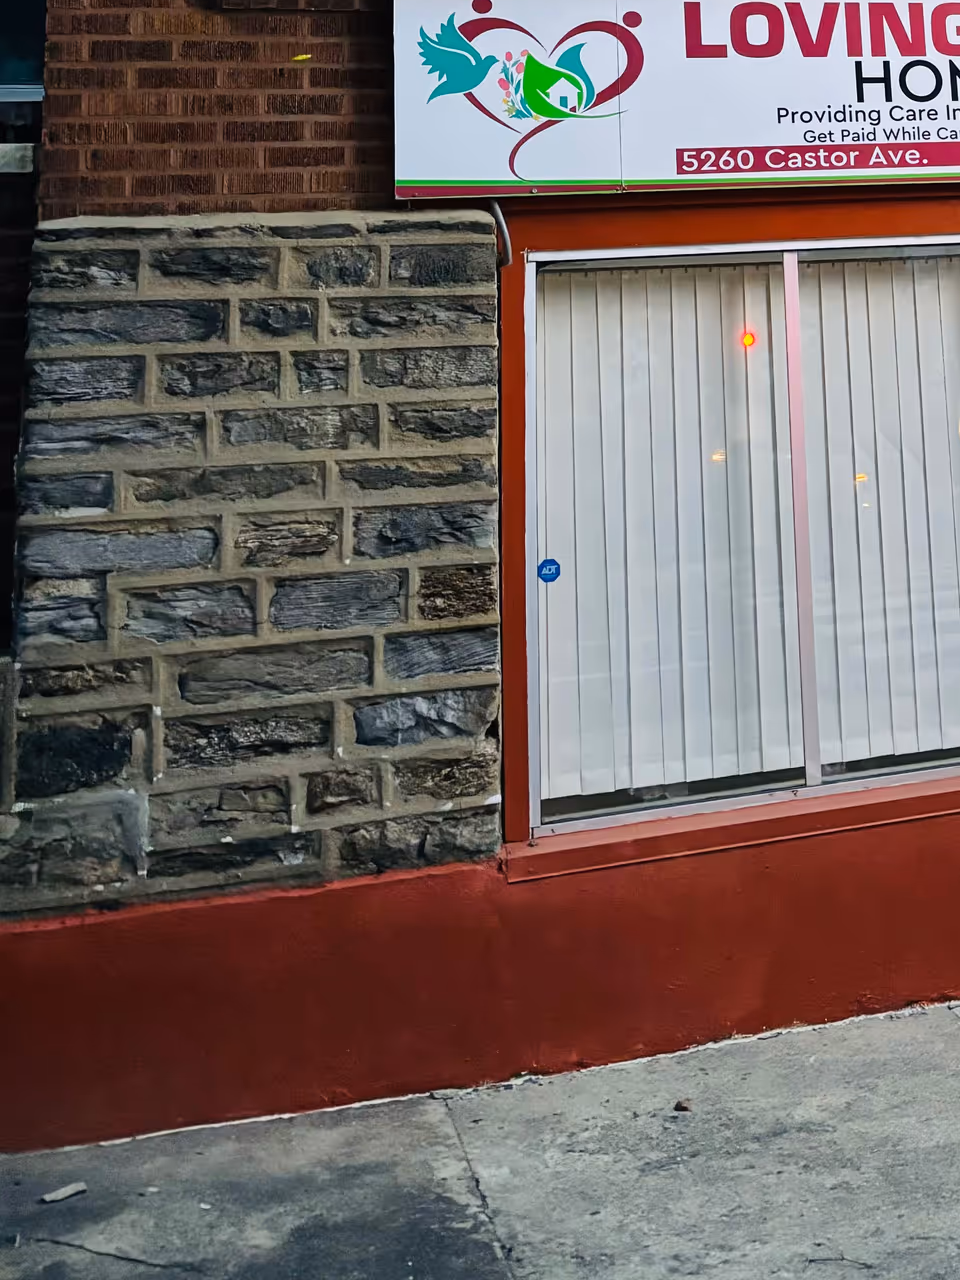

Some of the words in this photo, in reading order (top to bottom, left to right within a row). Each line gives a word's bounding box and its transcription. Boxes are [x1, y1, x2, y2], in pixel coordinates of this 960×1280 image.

[777, 105, 881, 125] Providing
[889, 105, 938, 121] Care
[803, 130, 835, 143] Get
[841, 128, 876, 142] Paid
[883, 127, 931, 141] While
[681, 149, 754, 172] 5260
[764, 147, 859, 169] Castor
[869, 146, 928, 166] Ave.
[541, 565, 558, 575] ADT
